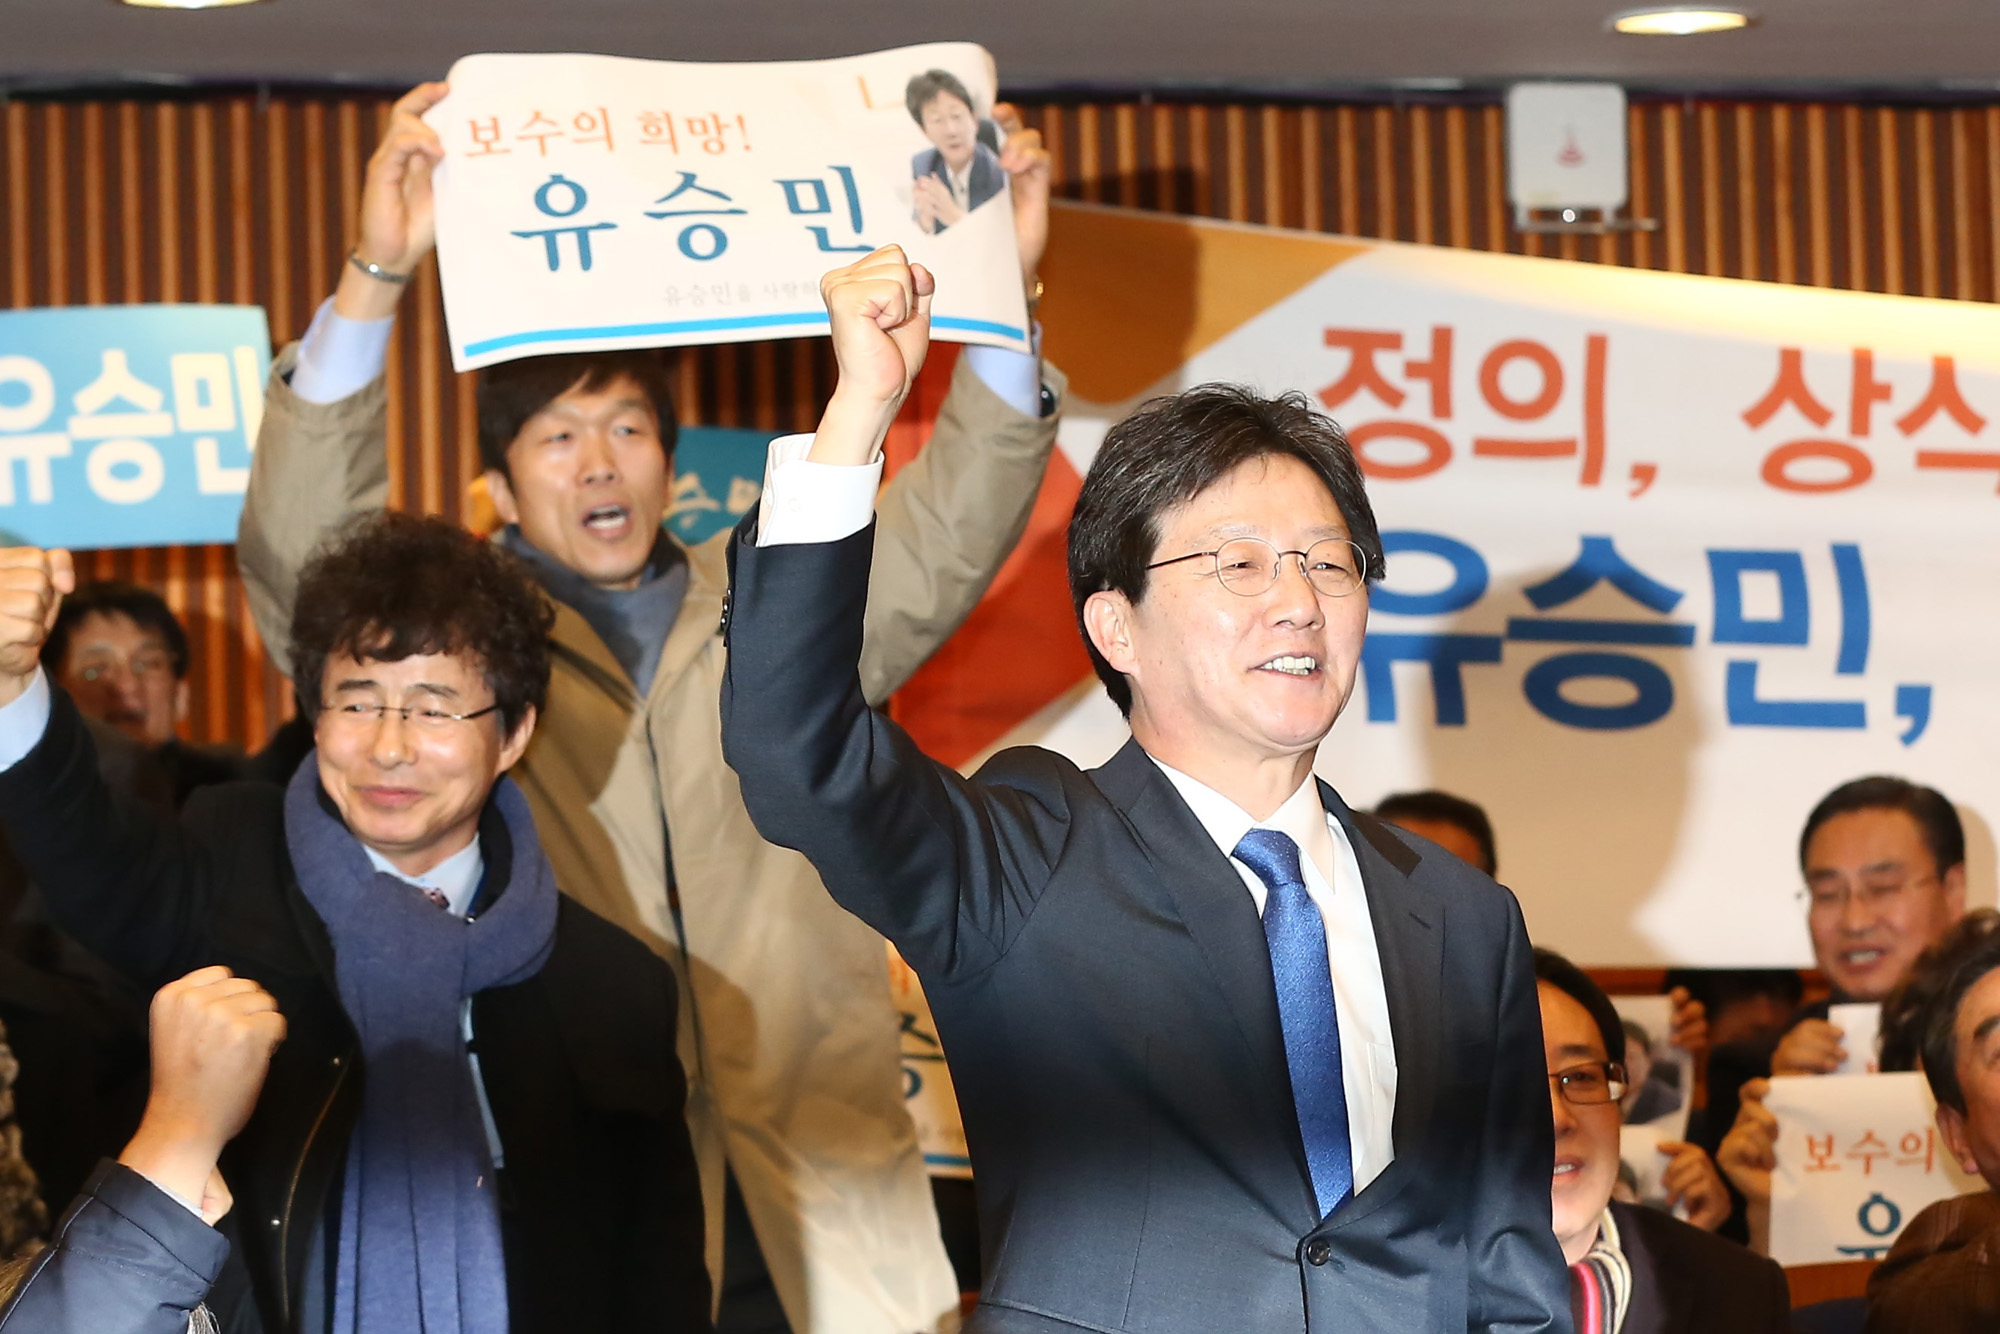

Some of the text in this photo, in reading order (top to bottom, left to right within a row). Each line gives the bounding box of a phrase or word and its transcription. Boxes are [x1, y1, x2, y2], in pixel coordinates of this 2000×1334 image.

[465, 106, 751, 157] 보수의 희망!
[510, 166, 876, 271] 유승민
[0, 346, 263, 505] 유승민
[1317, 324, 1657, 497] 정의,
[1361, 529, 1932, 746] 유승민,
[1804, 1127, 1935, 1176] 보수의
